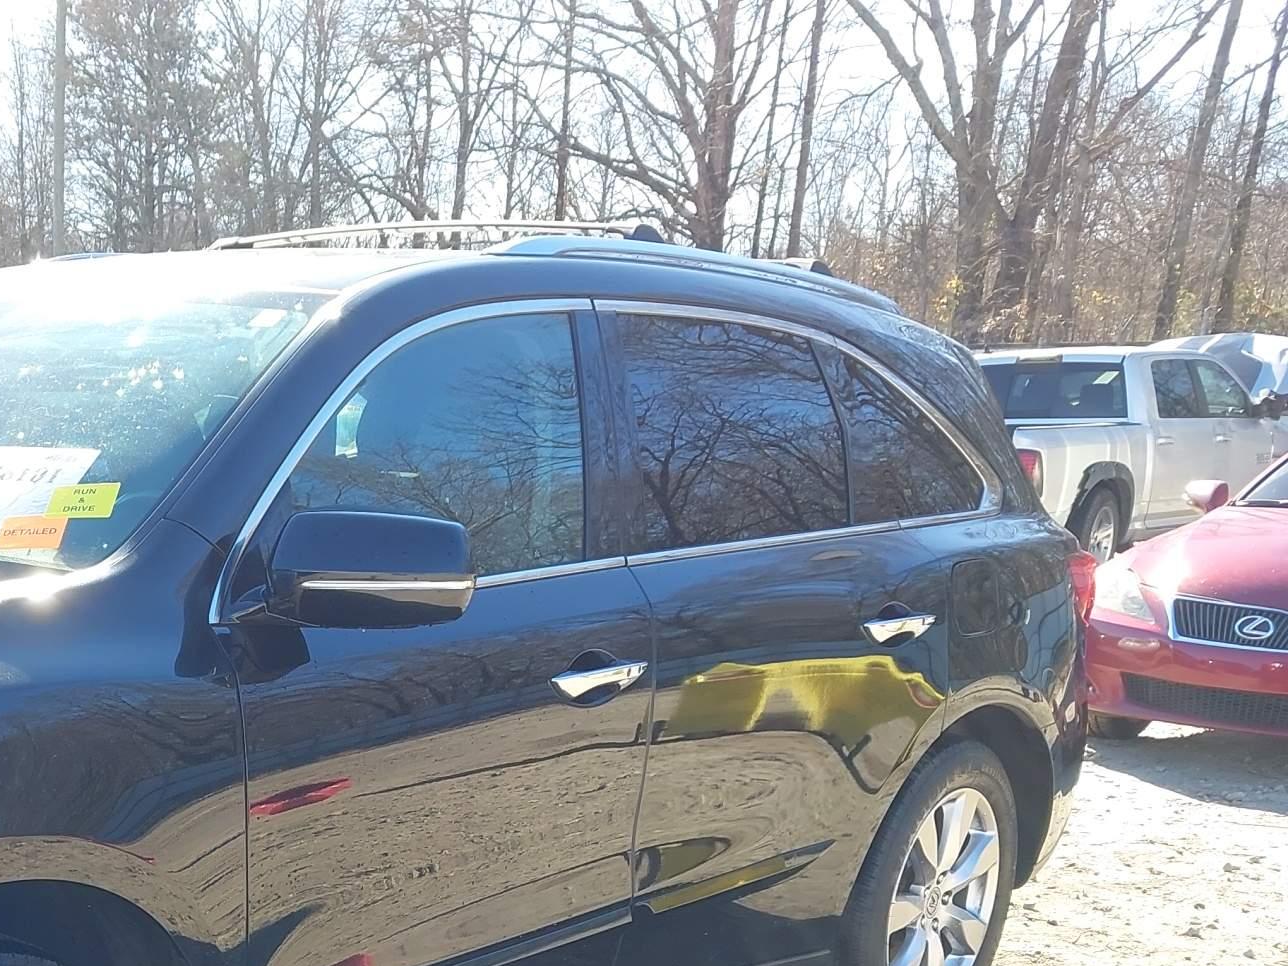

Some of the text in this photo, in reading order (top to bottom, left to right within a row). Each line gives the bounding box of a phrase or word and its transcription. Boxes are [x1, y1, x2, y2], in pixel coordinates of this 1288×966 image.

[72, 487, 97, 496] RUN
[62, 504, 97, 513] DRIVE
[2, 526, 58, 538] DETAILED
